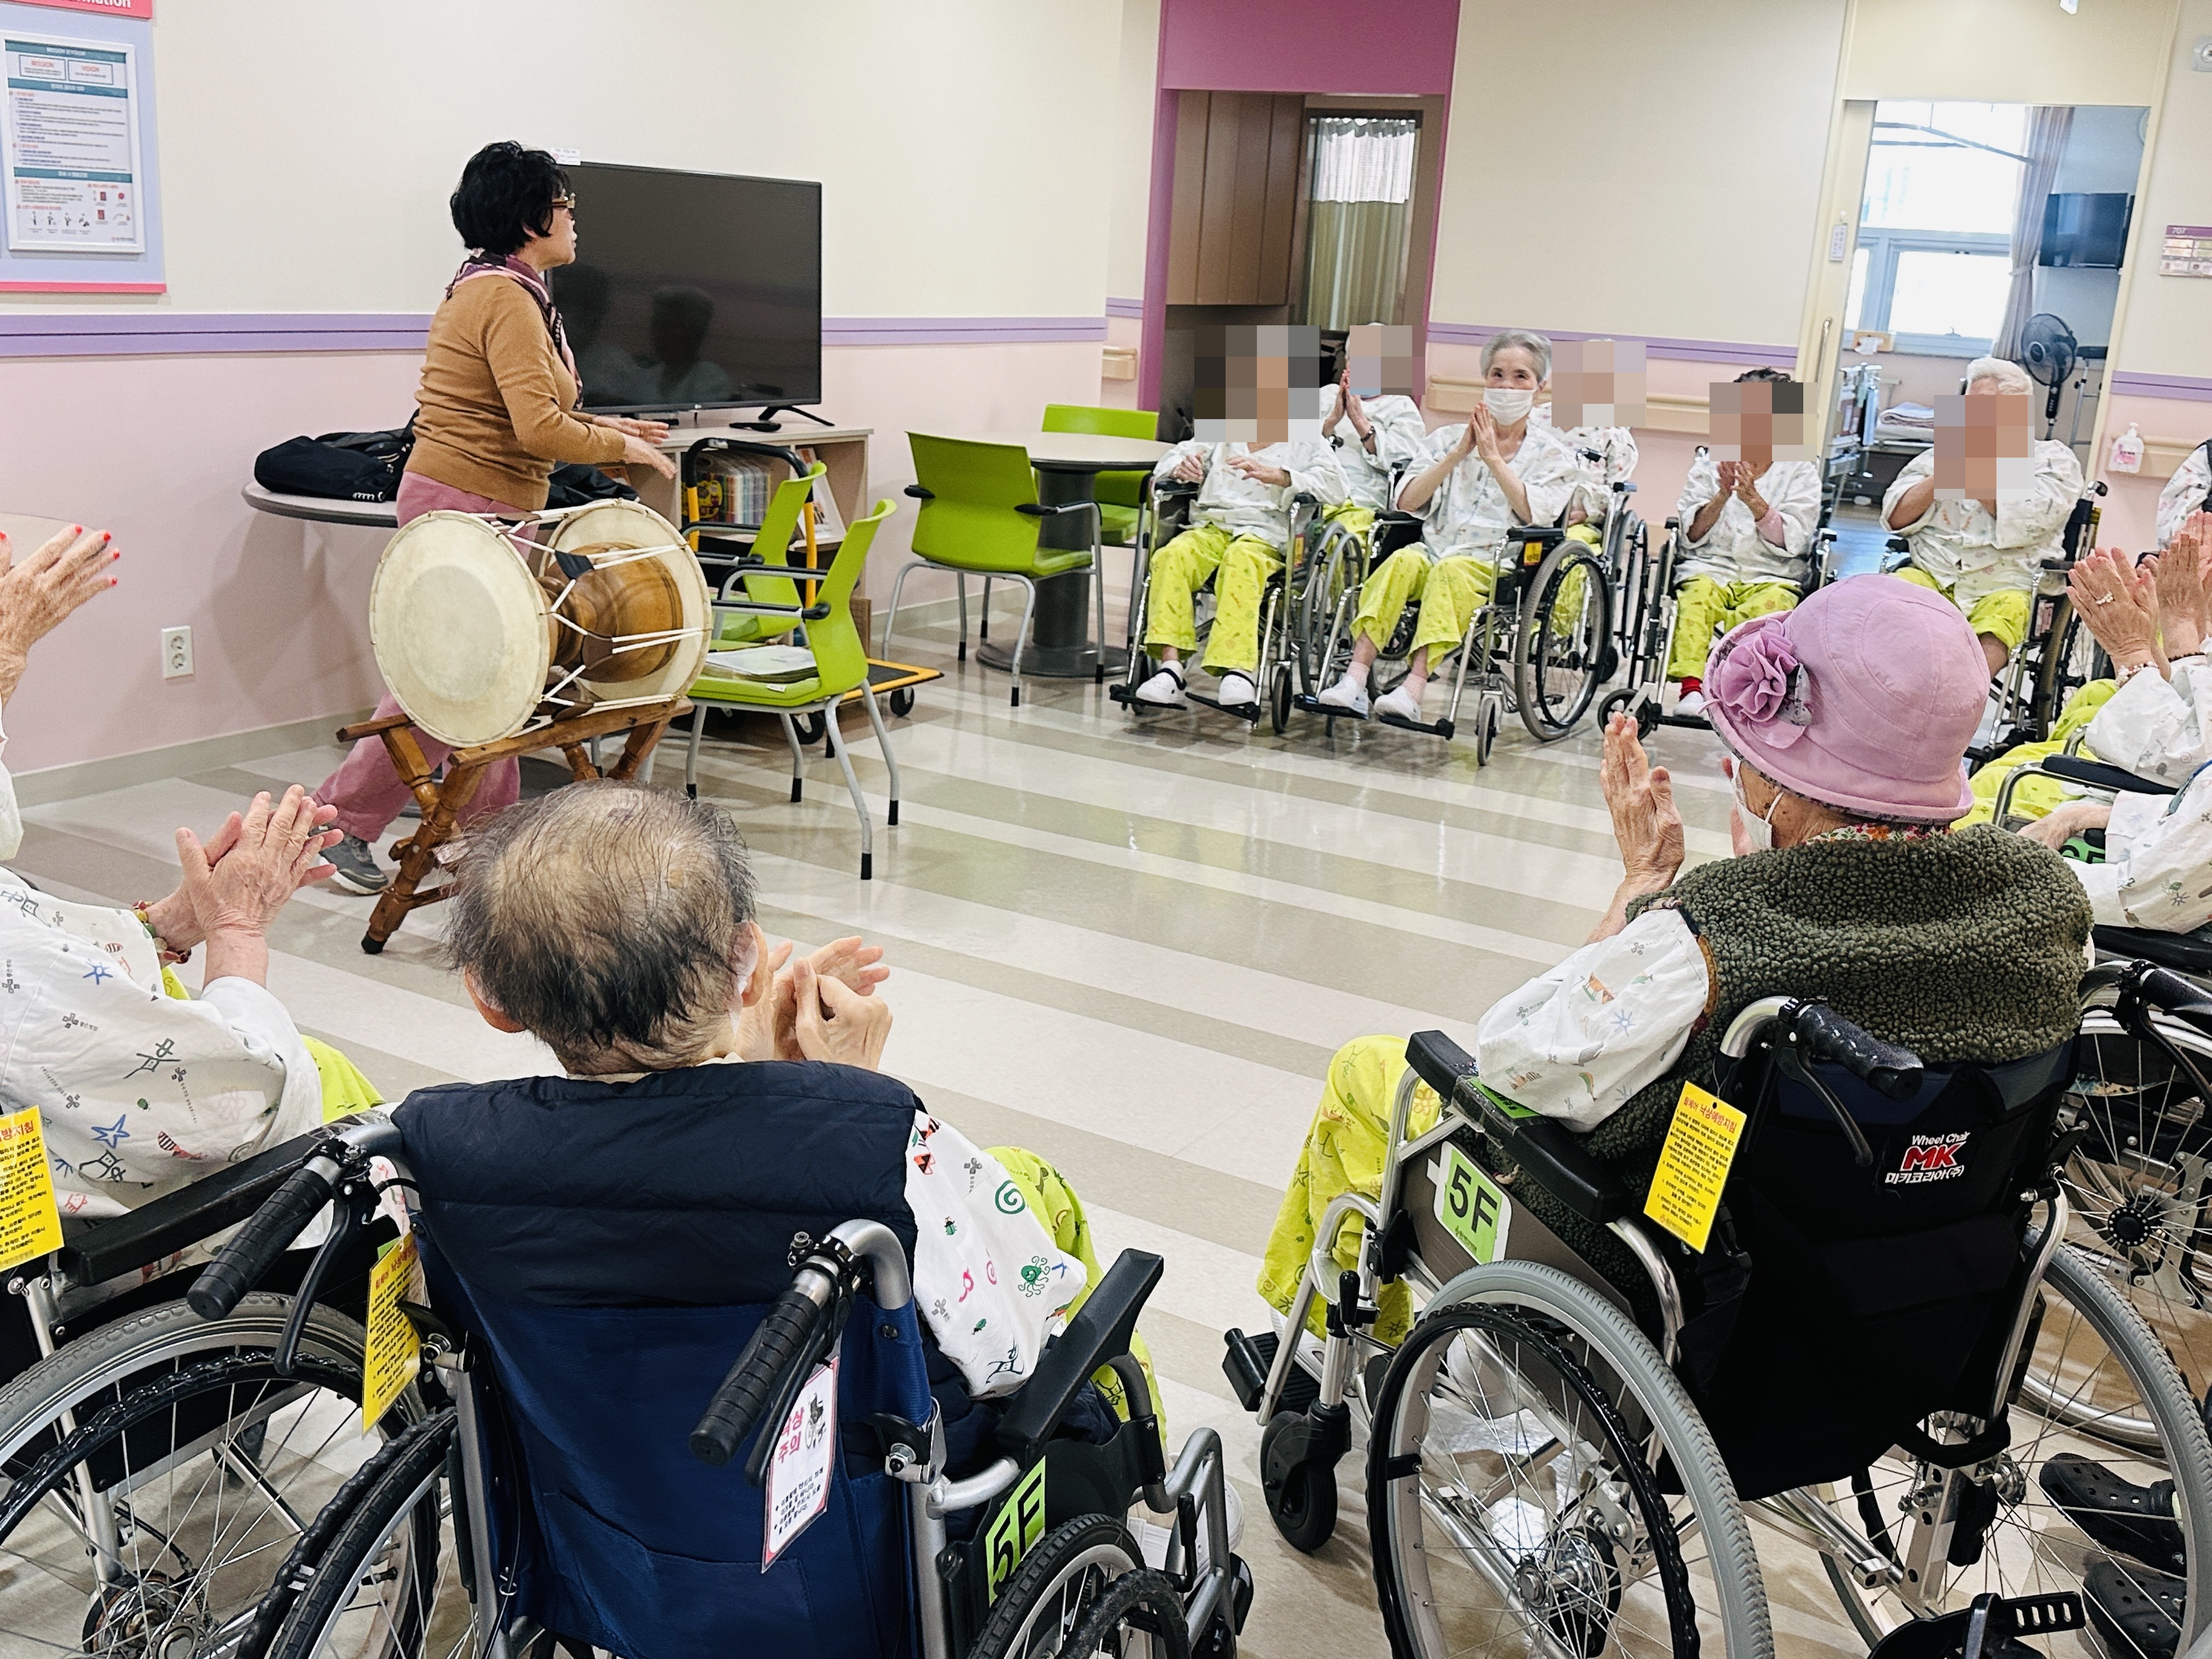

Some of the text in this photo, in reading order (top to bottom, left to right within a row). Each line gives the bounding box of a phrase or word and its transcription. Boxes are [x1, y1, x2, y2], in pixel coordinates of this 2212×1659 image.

[0, 1120, 33, 1141] 방지침
[1912, 1135, 1944, 1145] Wheel
[1899, 1141, 1967, 1171] MK
[1885, 1165, 1965, 1184] 미키코리아(주)
[1449, 1164, 1498, 1233] 5F
[777, 1430, 802, 1464] 주의
